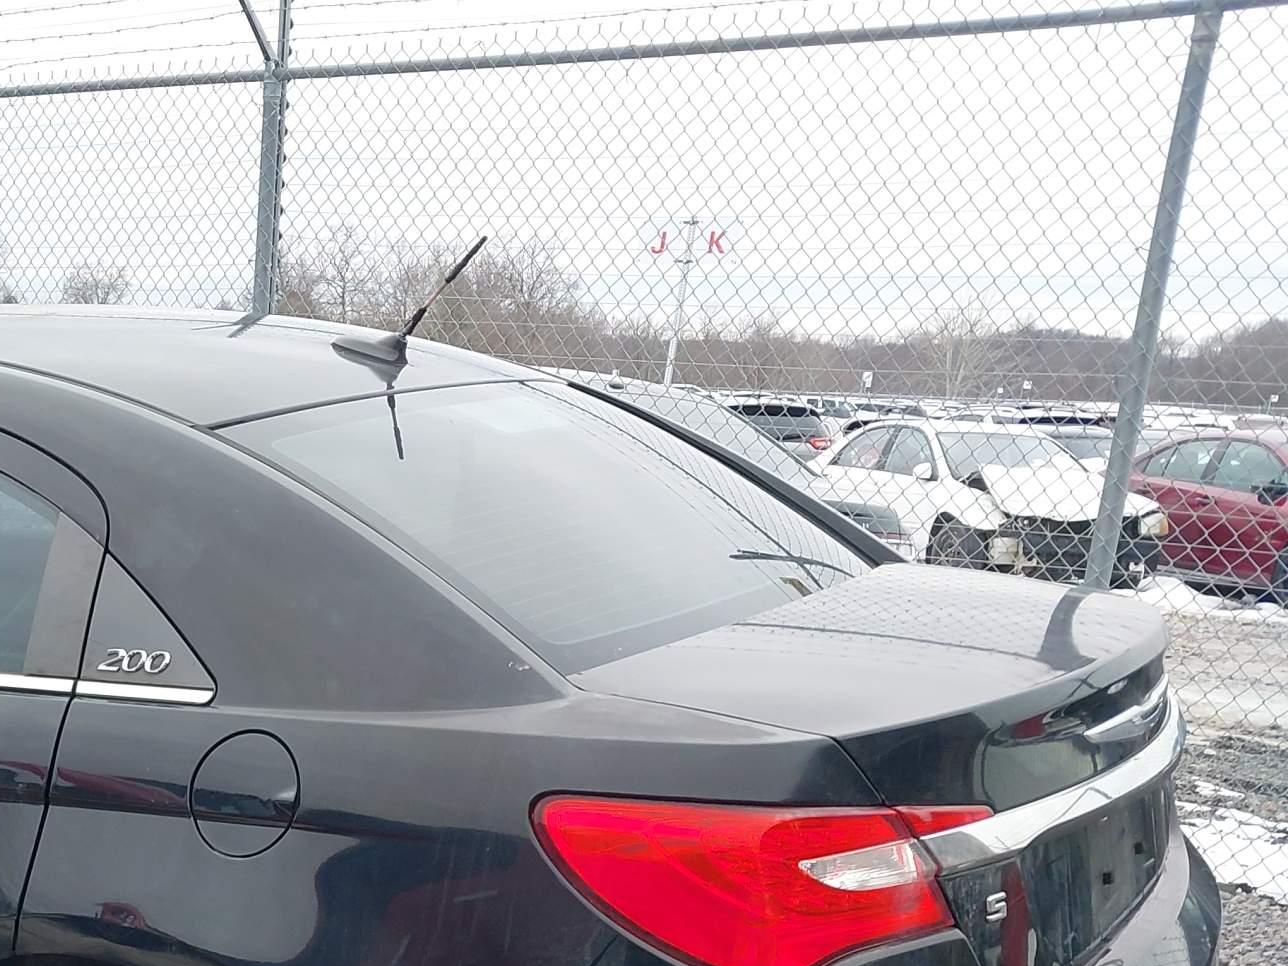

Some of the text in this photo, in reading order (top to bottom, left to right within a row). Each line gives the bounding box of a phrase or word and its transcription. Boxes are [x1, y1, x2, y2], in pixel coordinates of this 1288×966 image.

[650, 231, 667, 254] J
[707, 231, 726, 254] K
[96, 648, 171, 673] 200
[985, 891, 1008, 922] S
